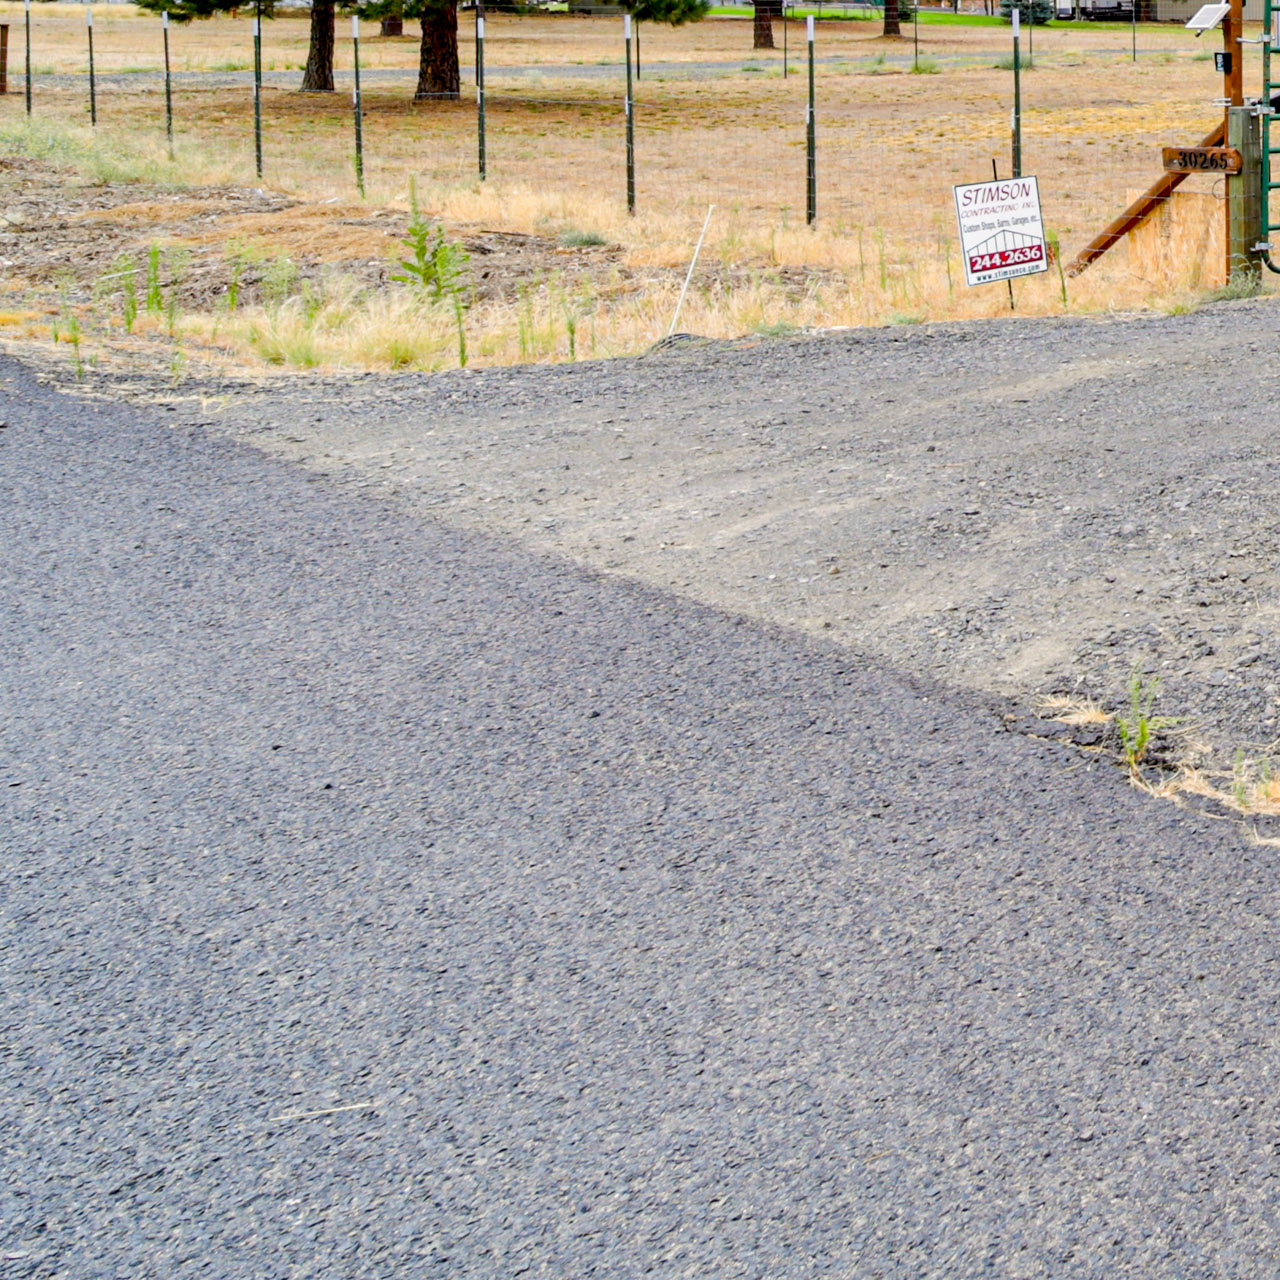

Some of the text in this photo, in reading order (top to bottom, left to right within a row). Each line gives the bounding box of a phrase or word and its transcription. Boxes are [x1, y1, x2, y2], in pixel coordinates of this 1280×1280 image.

[962, 183, 1030, 206] STIMSON
[961, 203, 1020, 219] CONTRACTING
[971, 246, 1041, 271] 244.2636
